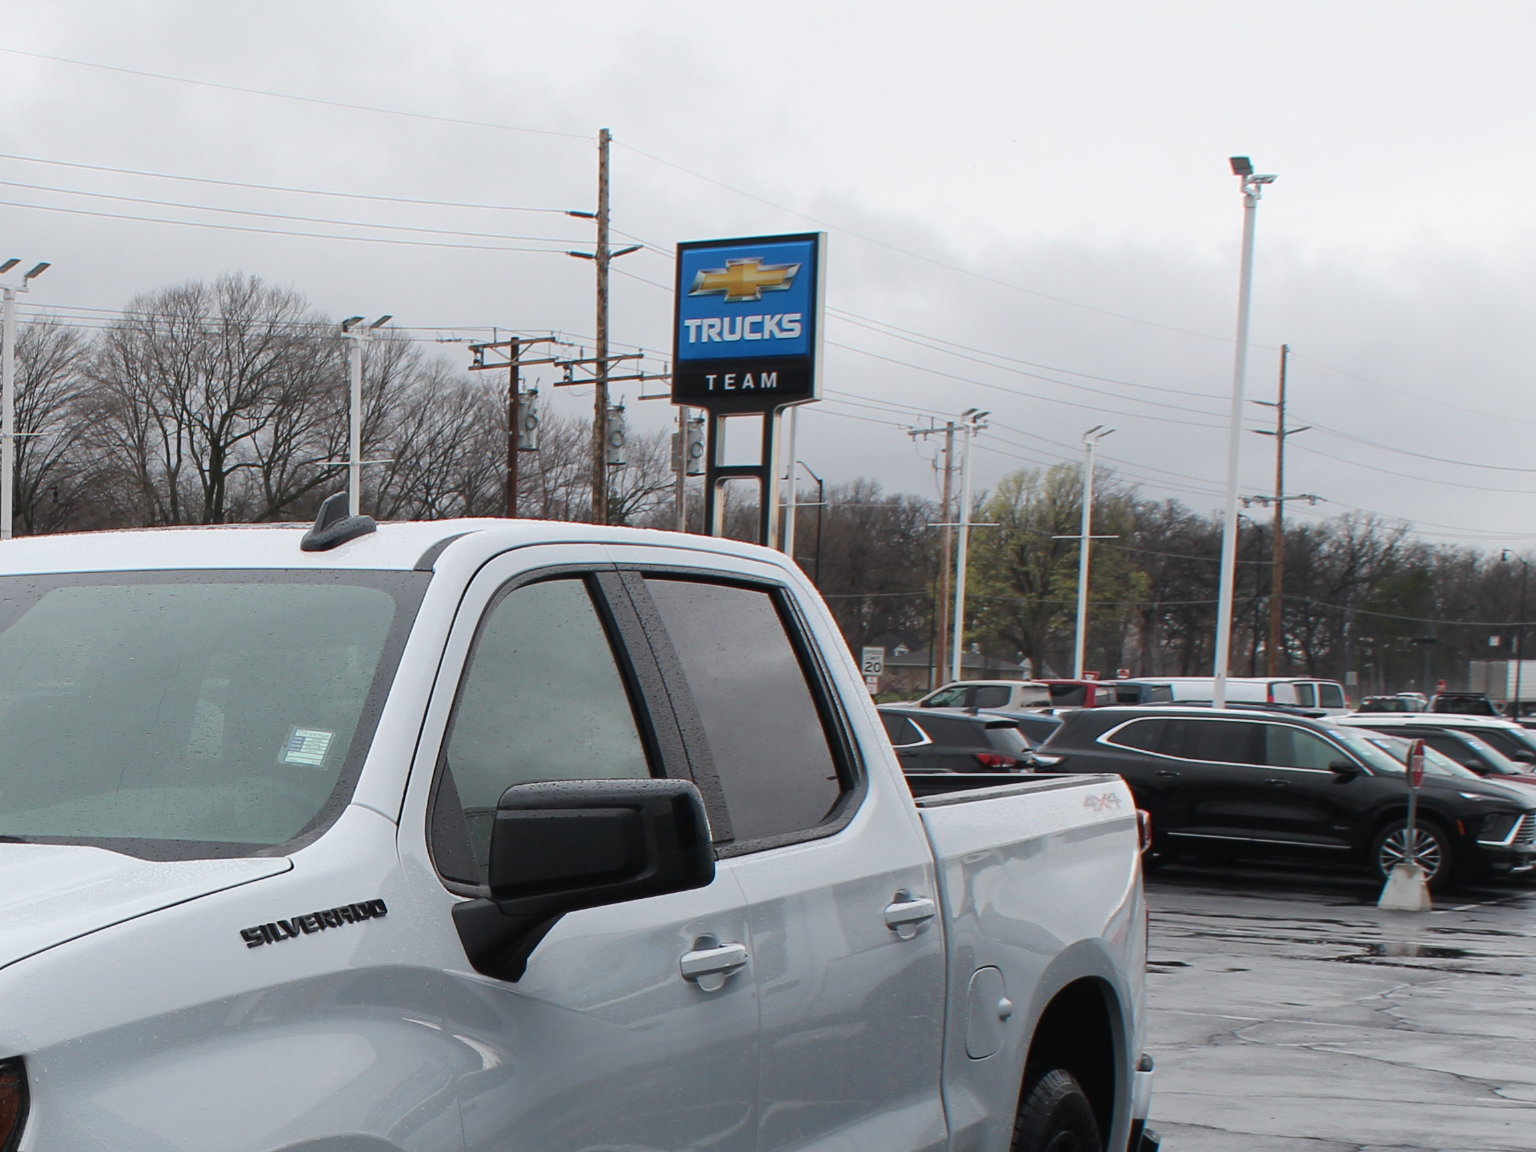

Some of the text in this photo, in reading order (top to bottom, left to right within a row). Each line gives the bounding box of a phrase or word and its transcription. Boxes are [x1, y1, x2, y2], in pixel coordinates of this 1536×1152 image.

[684, 313, 802, 343] TRUCKS
[706, 372, 778, 390] TEAM
[864, 661, 882, 672] 20
[240, 898, 388, 949] SILVERADO
